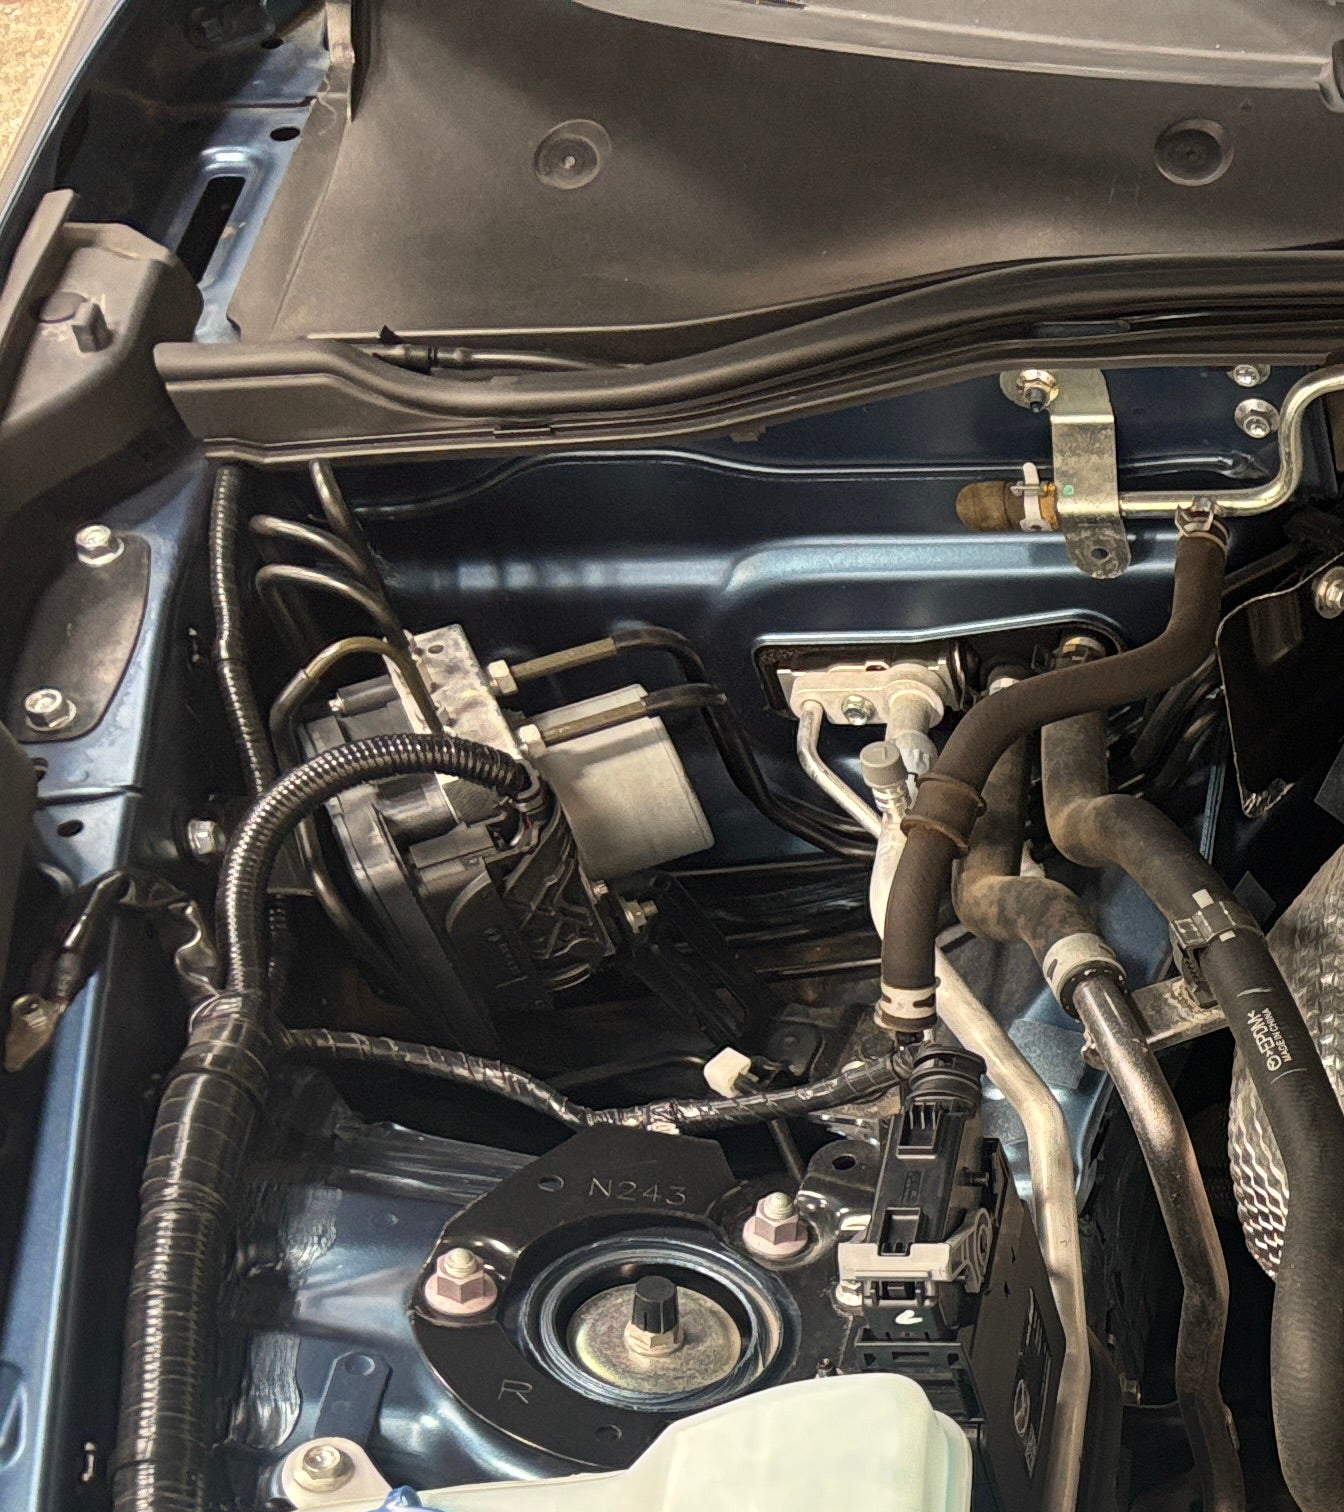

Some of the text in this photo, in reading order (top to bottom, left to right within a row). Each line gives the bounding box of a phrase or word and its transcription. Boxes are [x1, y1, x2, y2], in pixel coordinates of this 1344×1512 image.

[1261, 1007, 1279, 1032] CHINA
[1276, 1039, 1293, 1062] MADE
[588, 1177, 686, 1206] N243
[498, 1379, 533, 1404] R
